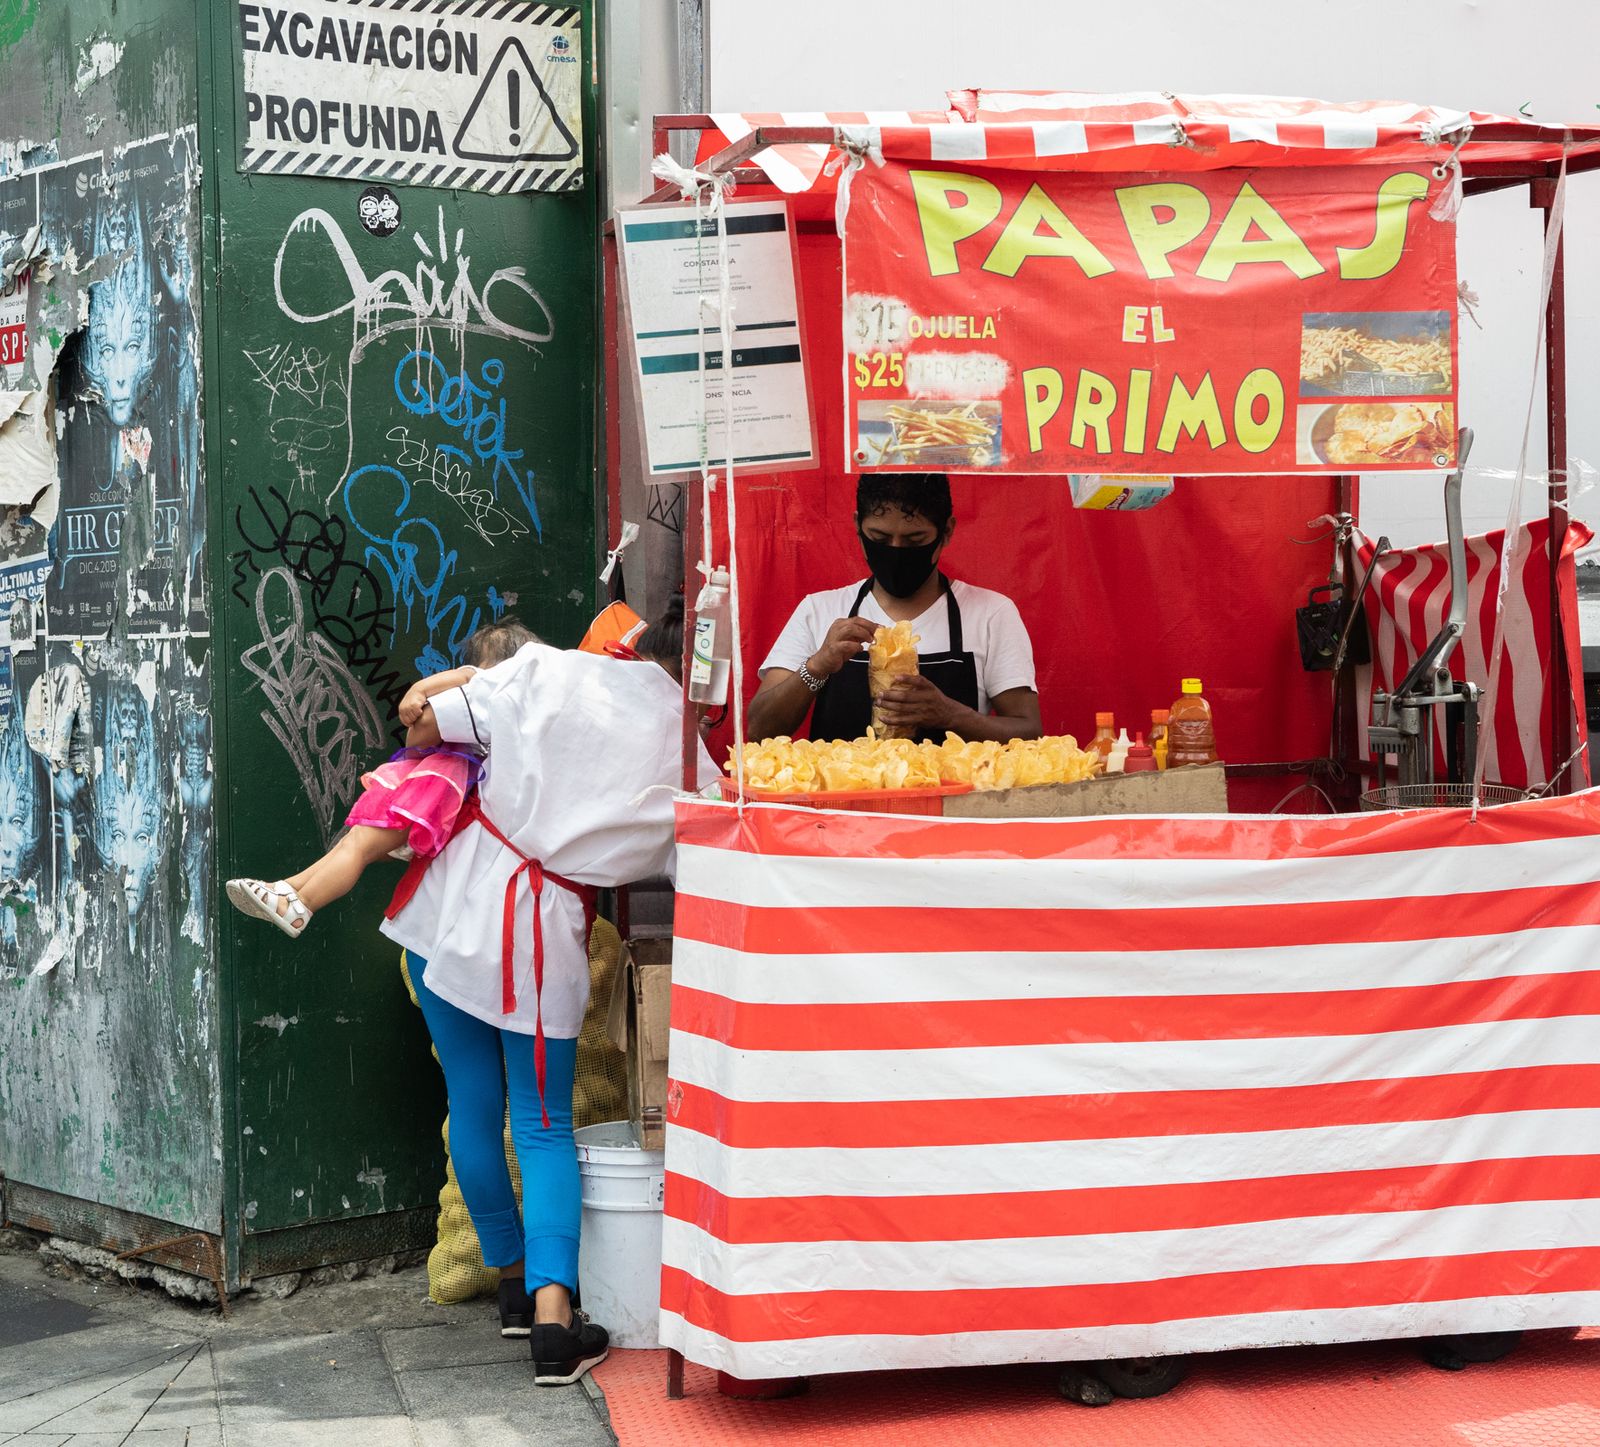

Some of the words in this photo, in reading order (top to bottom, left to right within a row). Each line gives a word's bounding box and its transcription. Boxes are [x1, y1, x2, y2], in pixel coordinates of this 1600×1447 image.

[241, 4, 478, 76] EXCAVACIÓN
[244, 92, 447, 155] PROFUNDA
[908, 169, 1430, 282] PAPAS
[683, 257, 736, 268] CONSTAA
[1122, 305, 1175, 343] EL
[854, 352, 904, 391] $25
[705, 389, 752, 400] ONSNCIA
[1022, 367, 1286, 454] PRIMO
[89, 491, 107, 503] SOLO
[67, 513, 100, 551] HR
[105, 506, 181, 549] GER
